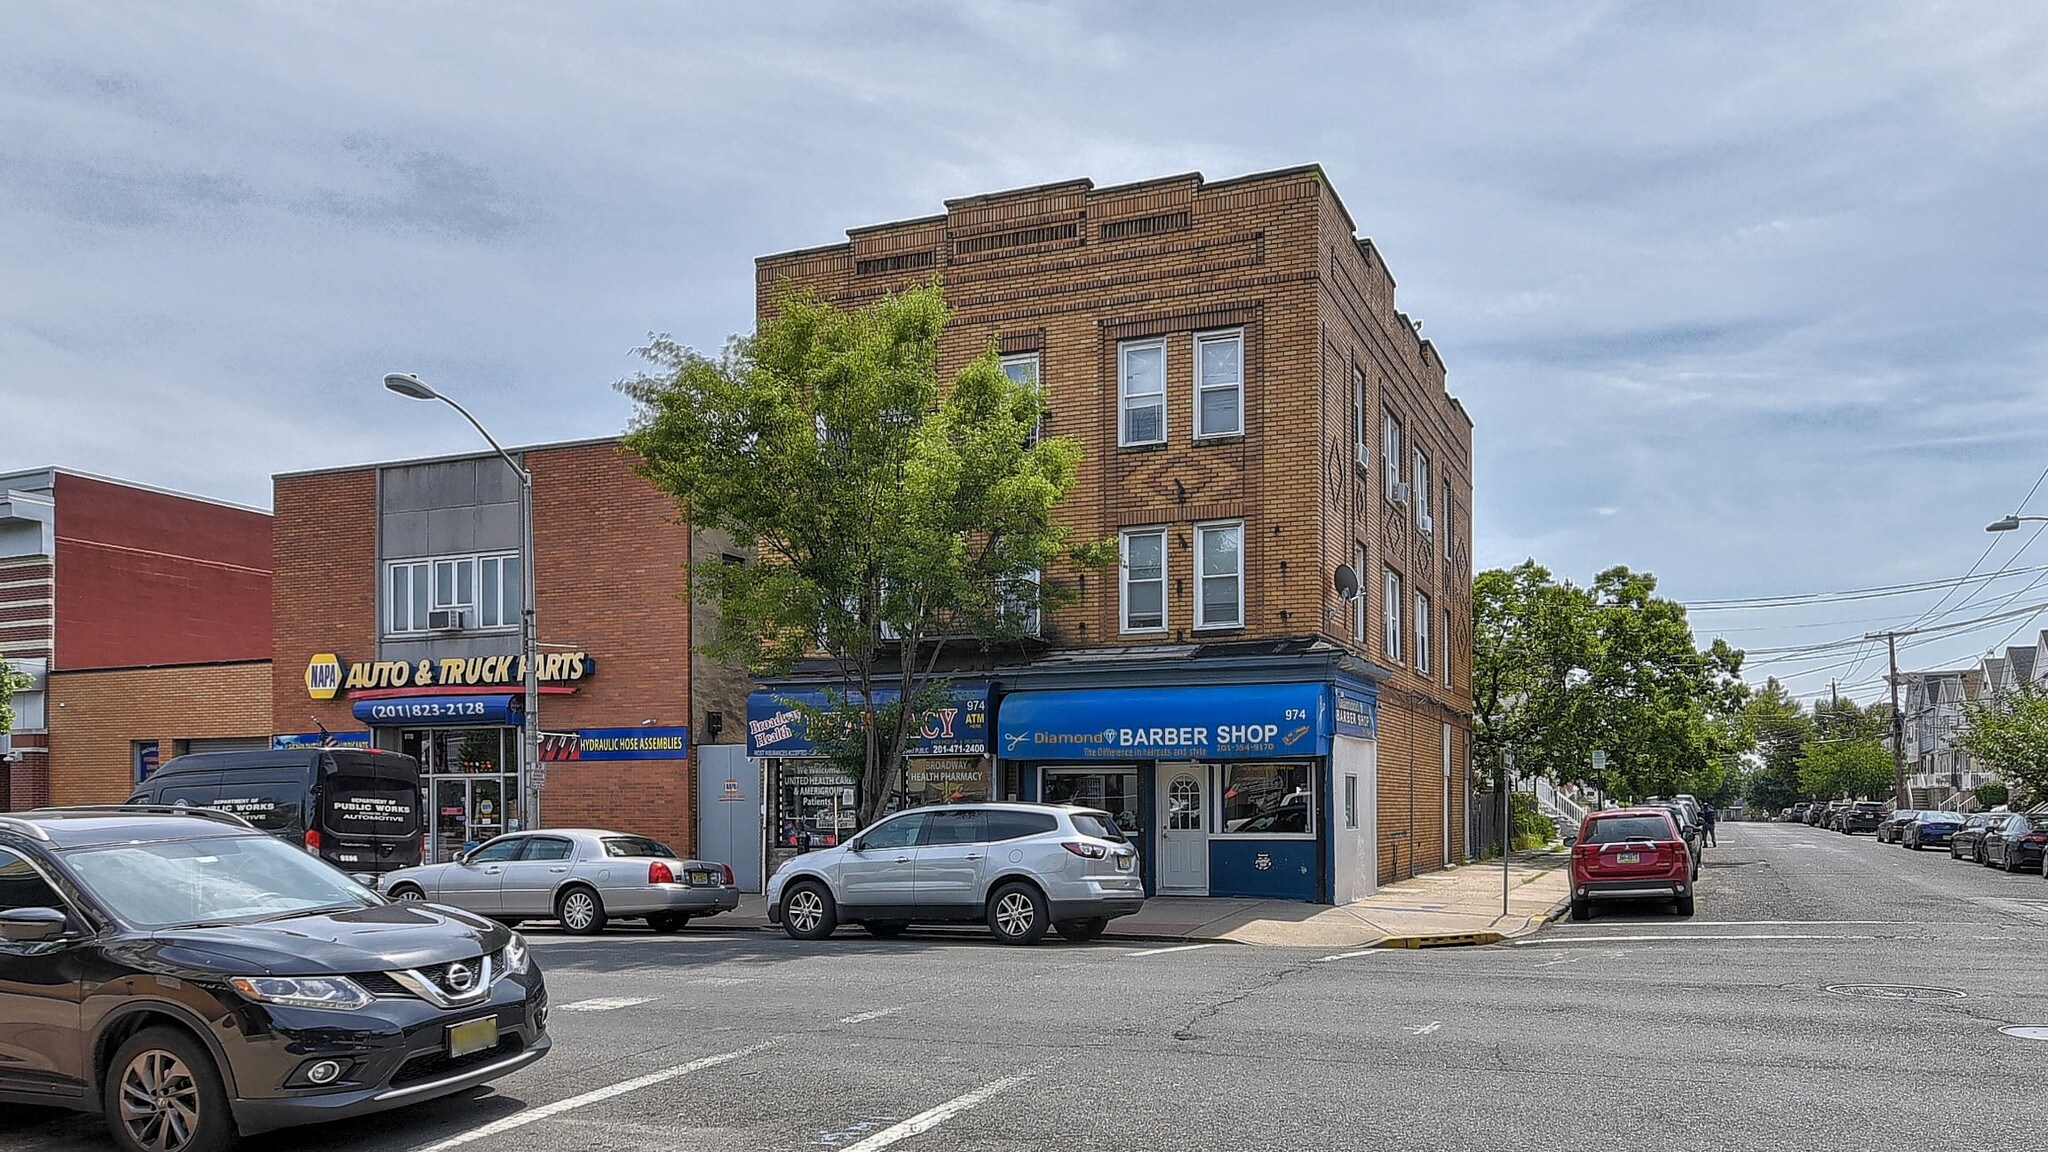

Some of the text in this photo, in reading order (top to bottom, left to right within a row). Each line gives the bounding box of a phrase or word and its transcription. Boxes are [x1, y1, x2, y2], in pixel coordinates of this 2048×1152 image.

[311, 664, 336, 688] NAPA
[345, 660, 409, 689] AUTO
[415, 658, 433, 686] &
[438, 655, 514, 685] TRUCK
[966, 700, 986, 712] 974
[965, 713, 985, 725] ATM
[1285, 709, 1306, 721] 974
[1336, 709, 1357, 725] BARBER
[755, 724, 793, 748] Health
[1034, 724, 1278, 747] Diamond BARBER SHOP
[580, 736, 682, 752] HYDRAULIC HOSE ASSEMBLIES
[932, 743, 985, 754] 201-471-2400
[925, 760, 968, 771] BROADWAY
[784, 776, 809, 785] UNITED
[809, 776, 834, 785] HEALTH
[911, 771, 983, 782] HEALTH PHARMACY
[793, 786, 843, 796] & AMERIGROUP
[351, 797, 387, 805] DEPARTMENT
[236, 803, 275, 812] WORKS
[334, 802, 411, 814] PUBLIC WORKS
[343, 813, 404, 822] AUTOMOTIVE
